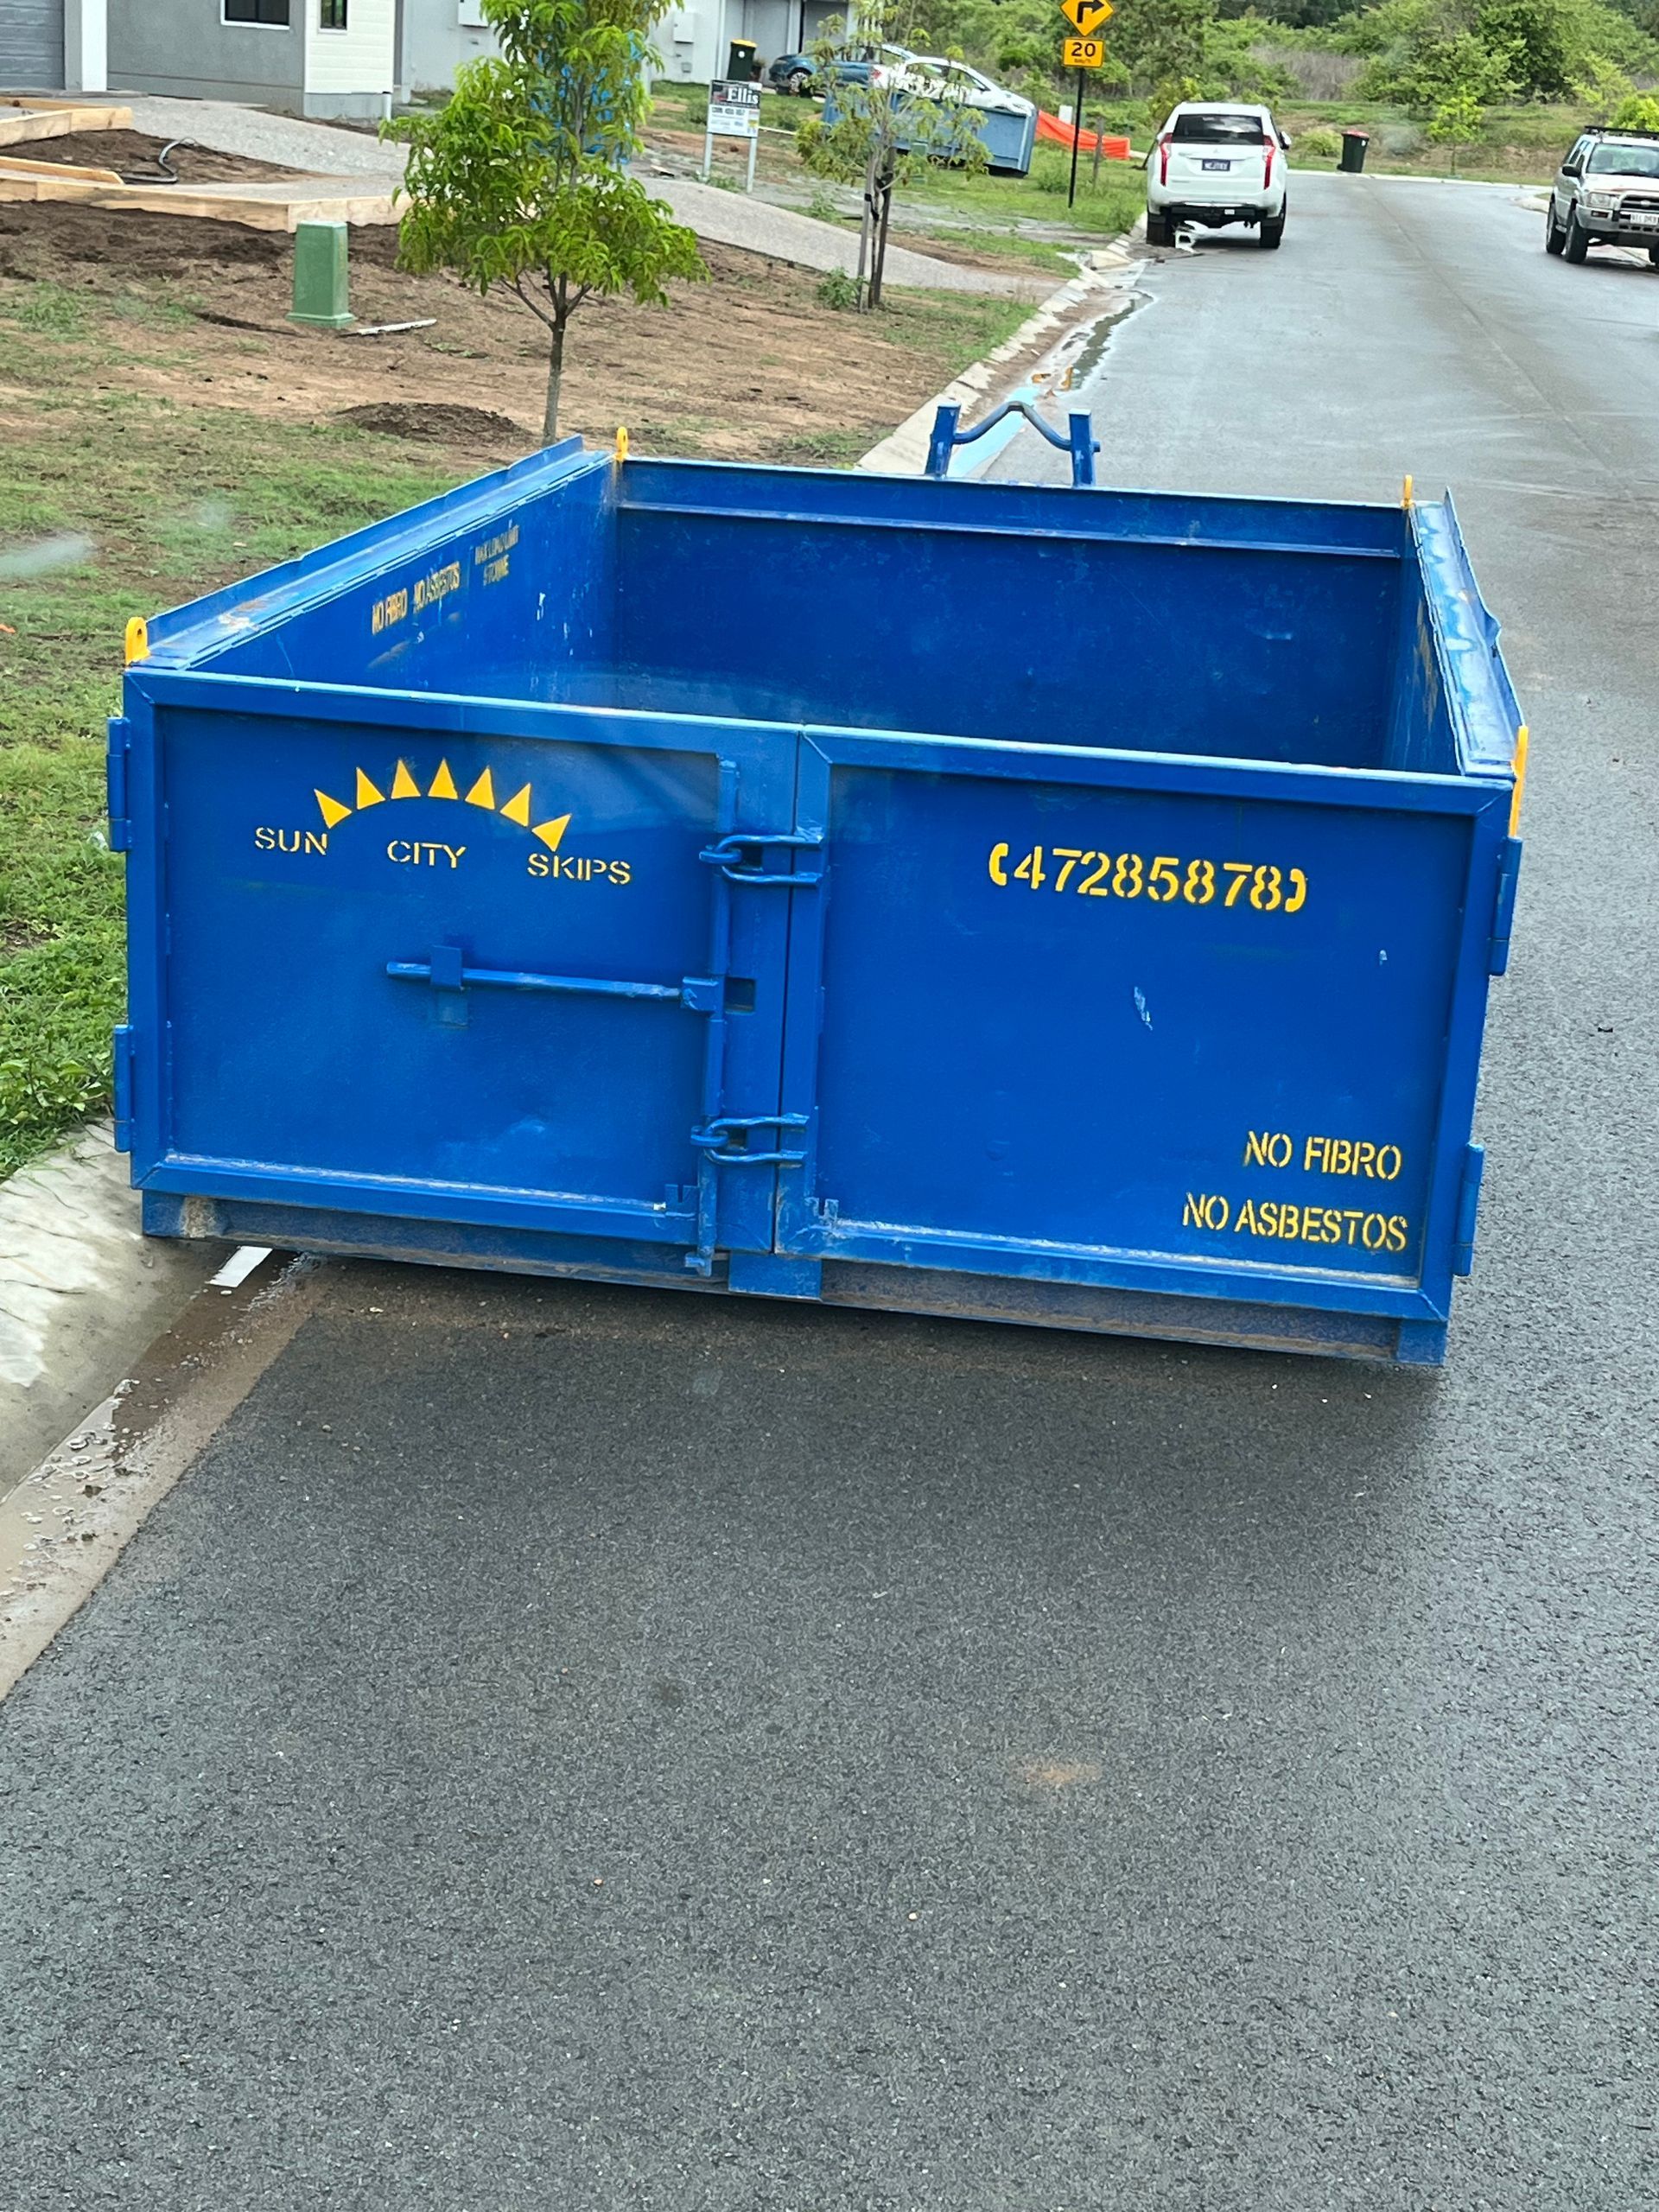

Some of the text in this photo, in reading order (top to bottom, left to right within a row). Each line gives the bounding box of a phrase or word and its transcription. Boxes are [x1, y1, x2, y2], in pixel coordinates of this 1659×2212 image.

[1071, 41, 1096, 57] 20
[727, 87, 759, 105] Ellis
[254, 827, 632, 886] SUN CITY SKIPS
[1245, 1130, 1402, 1180] NO FIBRO
[1183, 1193, 1408, 1253] NO ASBESTOS
